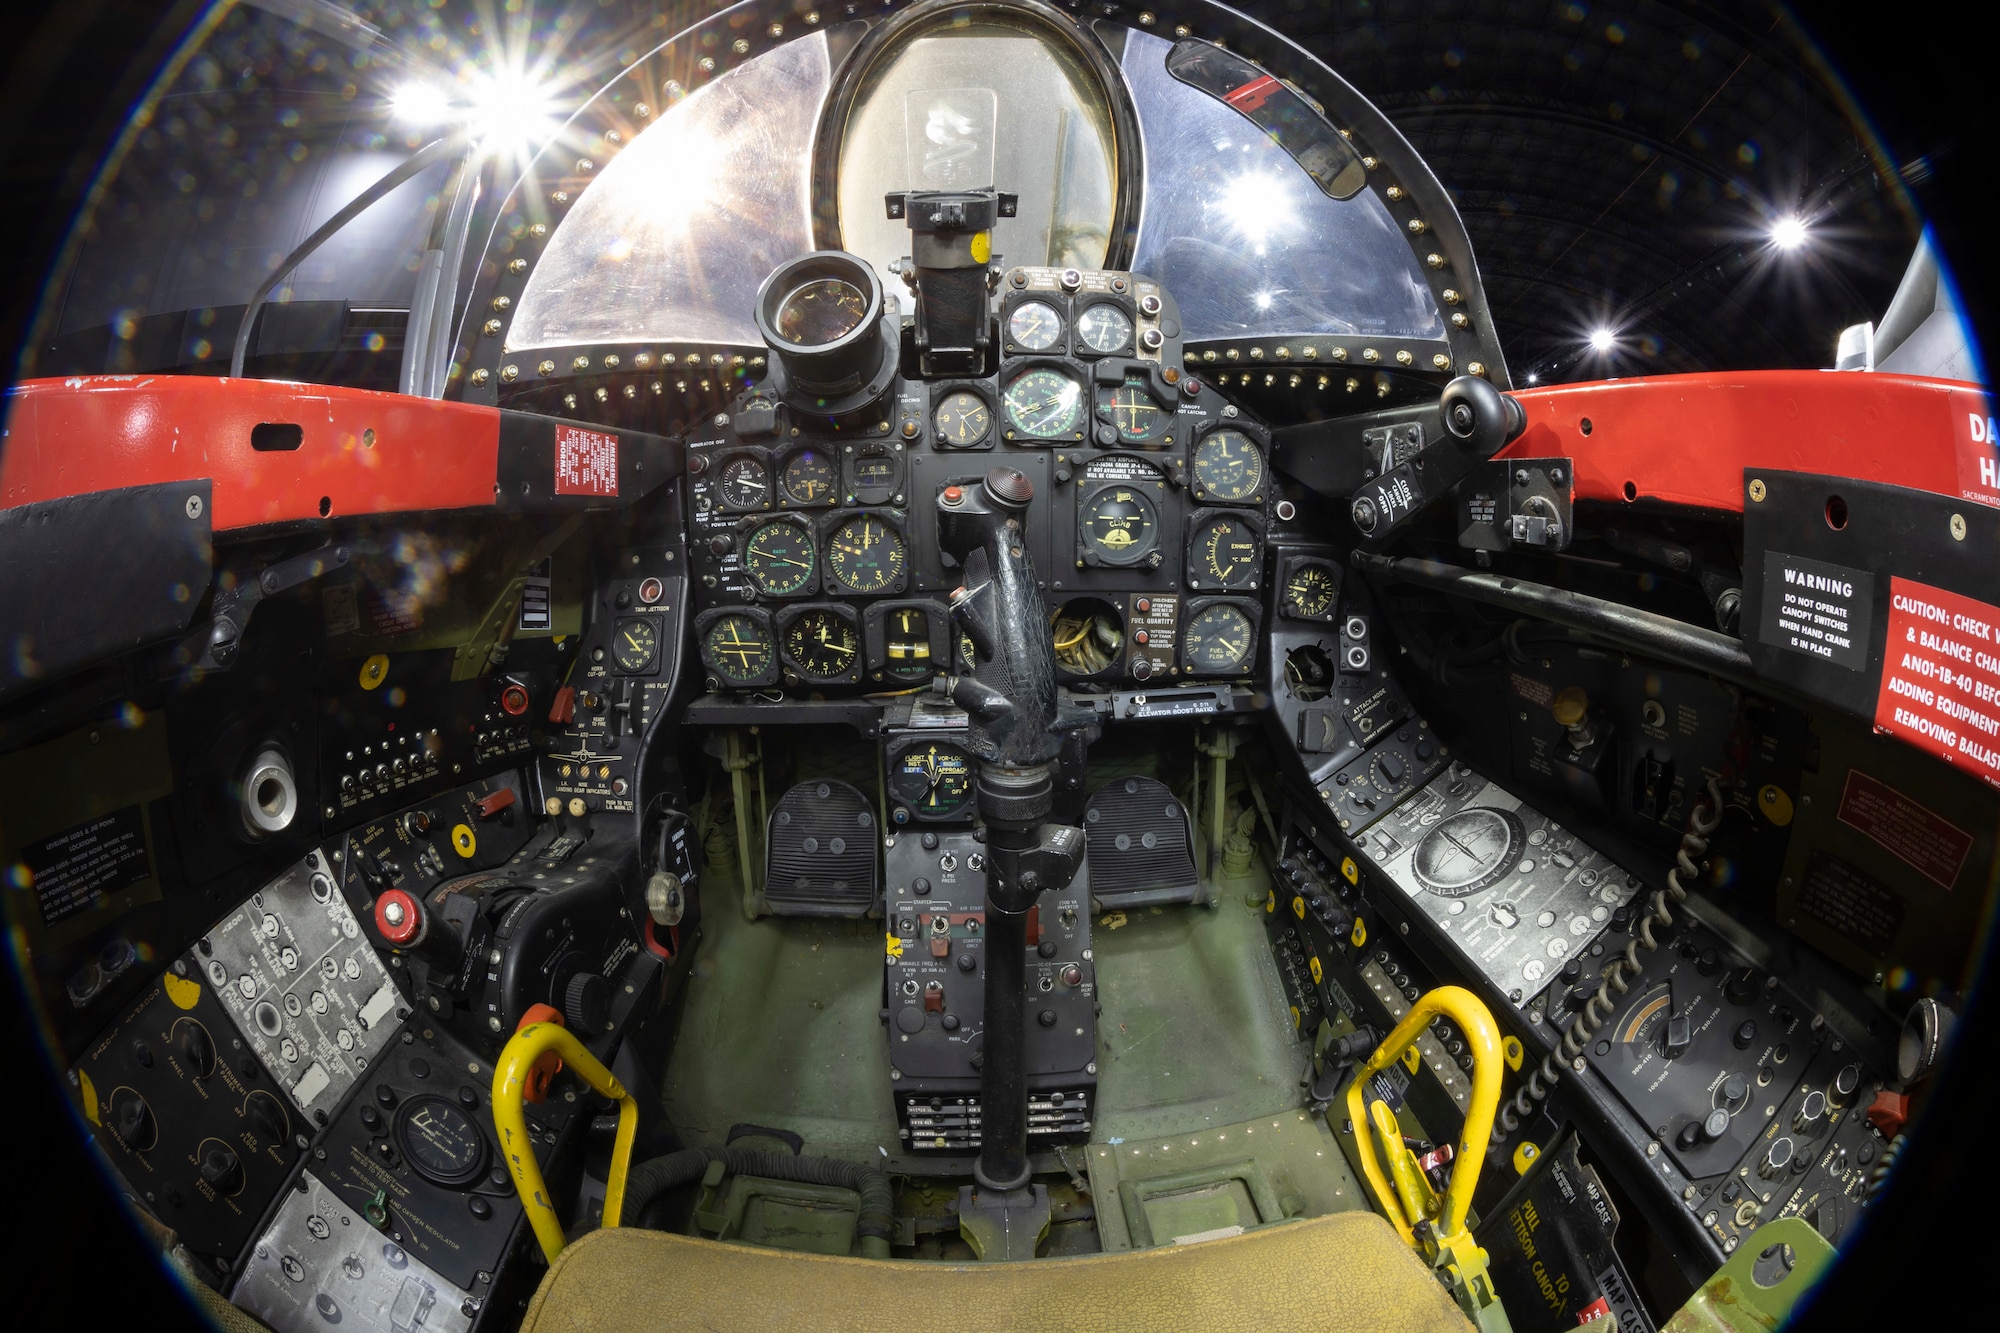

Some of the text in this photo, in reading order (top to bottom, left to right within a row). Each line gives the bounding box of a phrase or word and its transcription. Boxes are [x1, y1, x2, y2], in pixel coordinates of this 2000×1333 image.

[1387, 491, 1397, 508] LOCKS
[1392, 485, 1403, 507] CANOPY
[1400, 480, 1412, 502] CLOSE
[1378, 496, 1389, 514] OPEN
[1110, 520, 1131, 528] CLIMB
[838, 554, 844, 562] 5
[890, 552, 896, 561] 2
[876, 571, 882, 580] 3
[1784, 568, 1852, 598] WARNING
[1784, 593, 1847, 618] DO NOT OPERATE
[1782, 606, 1848, 632] CANOPY SWITCHES
[1893, 594, 1990, 640] CAUTION: CHECK
[1779, 620, 1850, 649] WHEN HAND CRANK
[1791, 637, 1832, 658] IS IN PLACE
[1906, 627, 2000, 675] & BALANCE CHA
[1901, 653, 1972, 692] AN01-1B-40
[1353, 688, 1386, 714] ATTACK MODE
[1888, 676, 2000, 737] ADDING EQUIPMENT
[1363, 719, 1393, 743] COMBAT APPROACH
[1894, 708, 2000, 771] REMOVING BALLAST
[1422, 760, 1440, 775] VOLUME
[1393, 785, 1415, 801] CHANNEL
[672, 828, 684, 842] LANDING
[283, 926, 295, 943] ARM
[250, 927, 281, 979] TANK RELEASE
[248, 956, 271, 989] TIP TANK
[250, 968, 263, 989] FUEL
[228, 986, 245, 1010] PYLON
[1332, 982, 1354, 1016] CANOPY
[1562, 984, 1574, 996] LOOP
[226, 993, 238, 1013] FUEL
[1684, 995, 1702, 1015] 410-850
[1702, 1007, 1722, 1031] 850-1750
[1787, 1018, 1800, 1035] VOICE
[161, 1032, 170, 1044] OFF
[283, 1011, 311, 1050] HOLD UNTIL
[254, 1033, 267, 1052] FUEL
[1632, 1053, 1652, 1076] 200-410
[1757, 1046, 1774, 1066] SPARES
[168, 1056, 184, 1079] PANEL
[217, 1056, 247, 1096] INSTRUMENT
[192, 1079, 209, 1100] BRIGHT
[220, 1071, 236, 1092] PANEL
[1648, 1070, 1669, 1092] 100-200
[1707, 1070, 1726, 1092] TUNING
[234, 1107, 244, 1118] OFF
[106, 1122, 130, 1154] CONSOLE
[246, 1132, 258, 1144] RED
[421, 1132, 434, 1142] FLOW
[1766, 1123, 1780, 1138] CHAN
[240, 1133, 257, 1154] FLOOD
[188, 1154, 198, 1166] OFF
[268, 1148, 284, 1166] BRIGHT
[1820, 1150, 1834, 1168] MODE
[364, 1157, 396, 1184] EMERGENCY
[1842, 1168, 1851, 1181] OUT
[375, 1169, 389, 1183] TEST
[390, 1182, 406, 1198] MASK
[350, 1166, 460, 1250] PRESSURE AND OXYGEN REGULATOR
[1586, 1182, 1612, 1226] MAP CASE
[1779, 1188, 1803, 1218] MASTER
[1522, 1199, 1570, 1294] PULL TO
[1532, 1260, 1560, 1310] CANOPY
[1602, 1273, 1625, 1305] MAP
